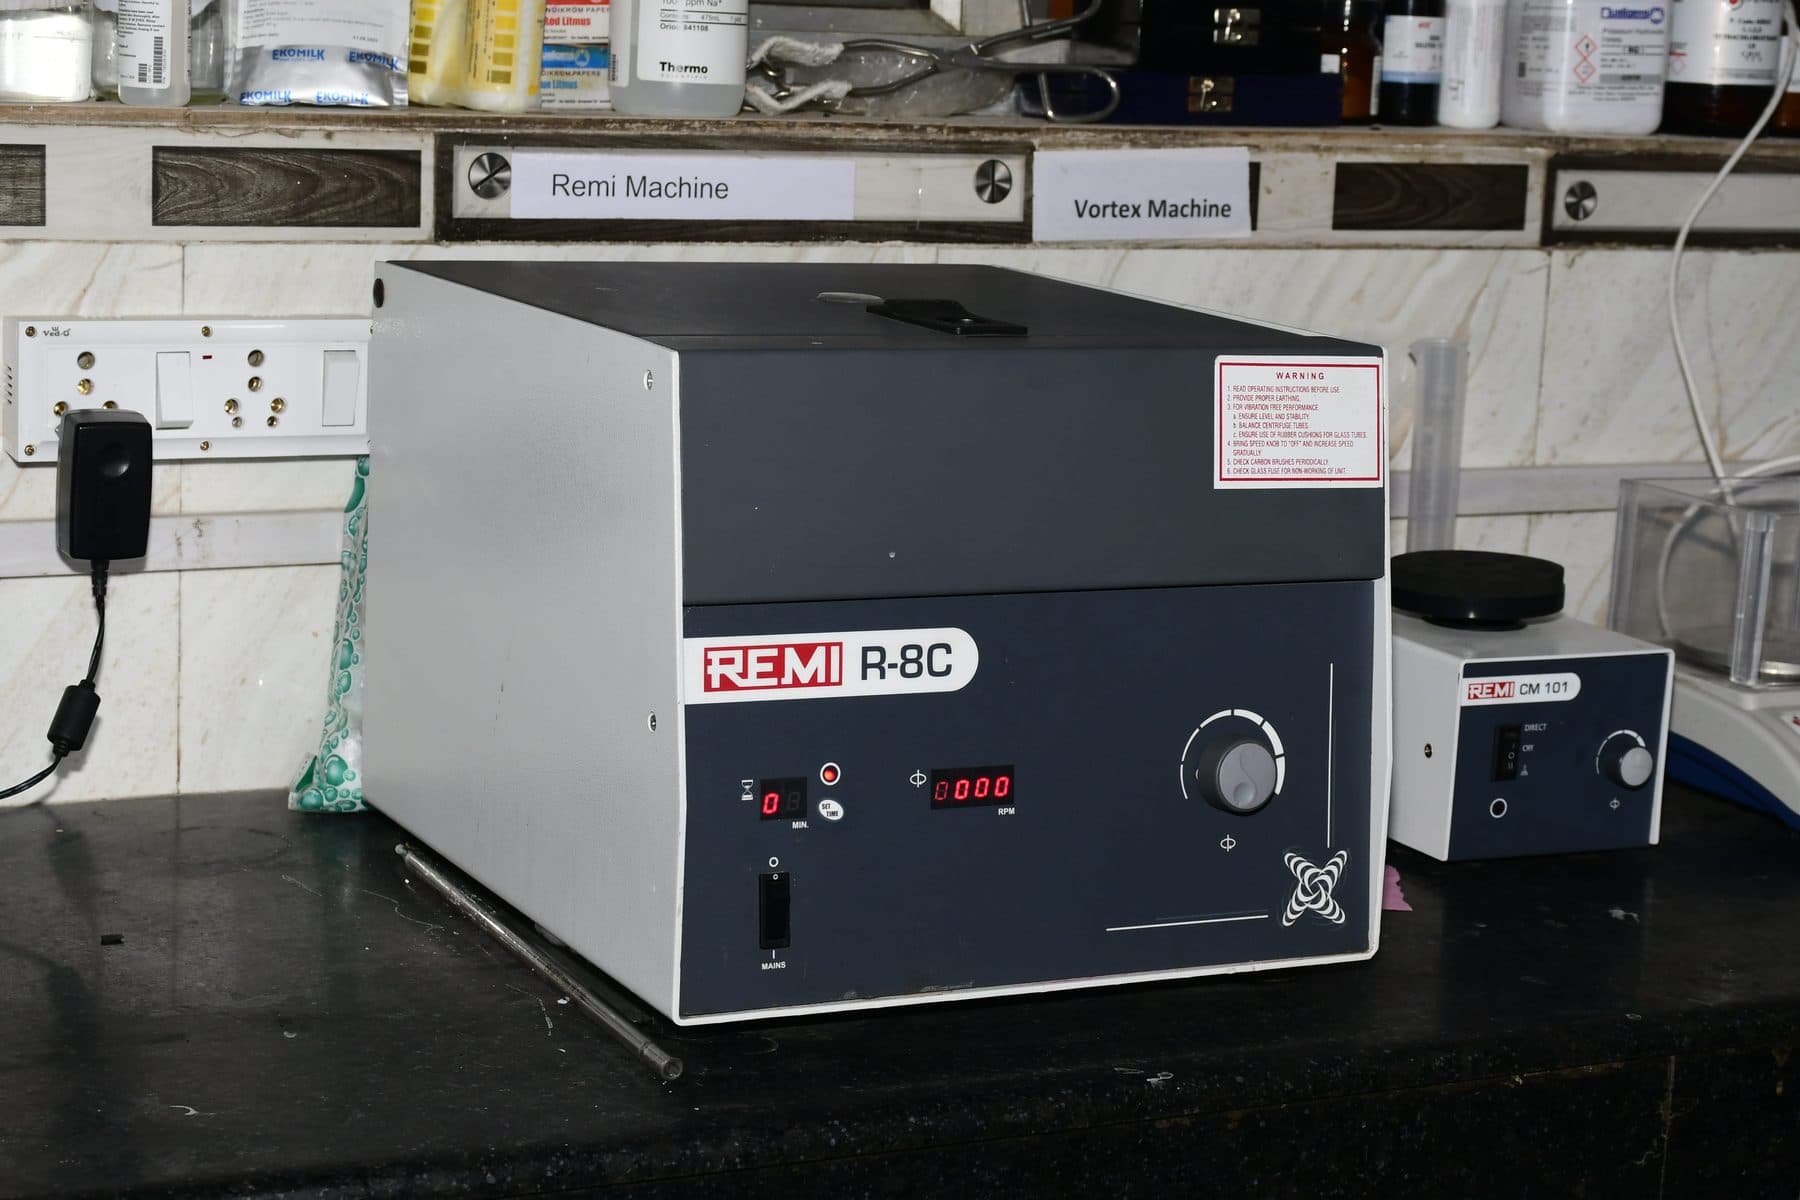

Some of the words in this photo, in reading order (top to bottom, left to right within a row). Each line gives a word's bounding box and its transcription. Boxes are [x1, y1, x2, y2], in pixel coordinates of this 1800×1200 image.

[562, 17, 591, 26] Litmus
[272, 48, 325, 61] EKOMILK
[659, 61, 708, 73] Thermo
[240, 90, 292, 105] EKOMILK
[551, 173, 616, 198] Remi
[626, 174, 729, 200] Machine
[1074, 198, 1140, 218] Vortex
[1147, 199, 1232, 218] Machine
[1276, 372, 1325, 380] WARNING
[704, 644, 841, 690] REMI
[861, 643, 952, 680] R-8C
[1468, 682, 1515, 700] REMI
[1519, 684, 1540, 695] CM
[1545, 682, 1568, 694] 101
[1524, 723, 1547, 732] DIRECT
[762, 793, 779, 814] 0
[998, 808, 1015, 816] RPM
[761, 961, 786, 970] MAINS
